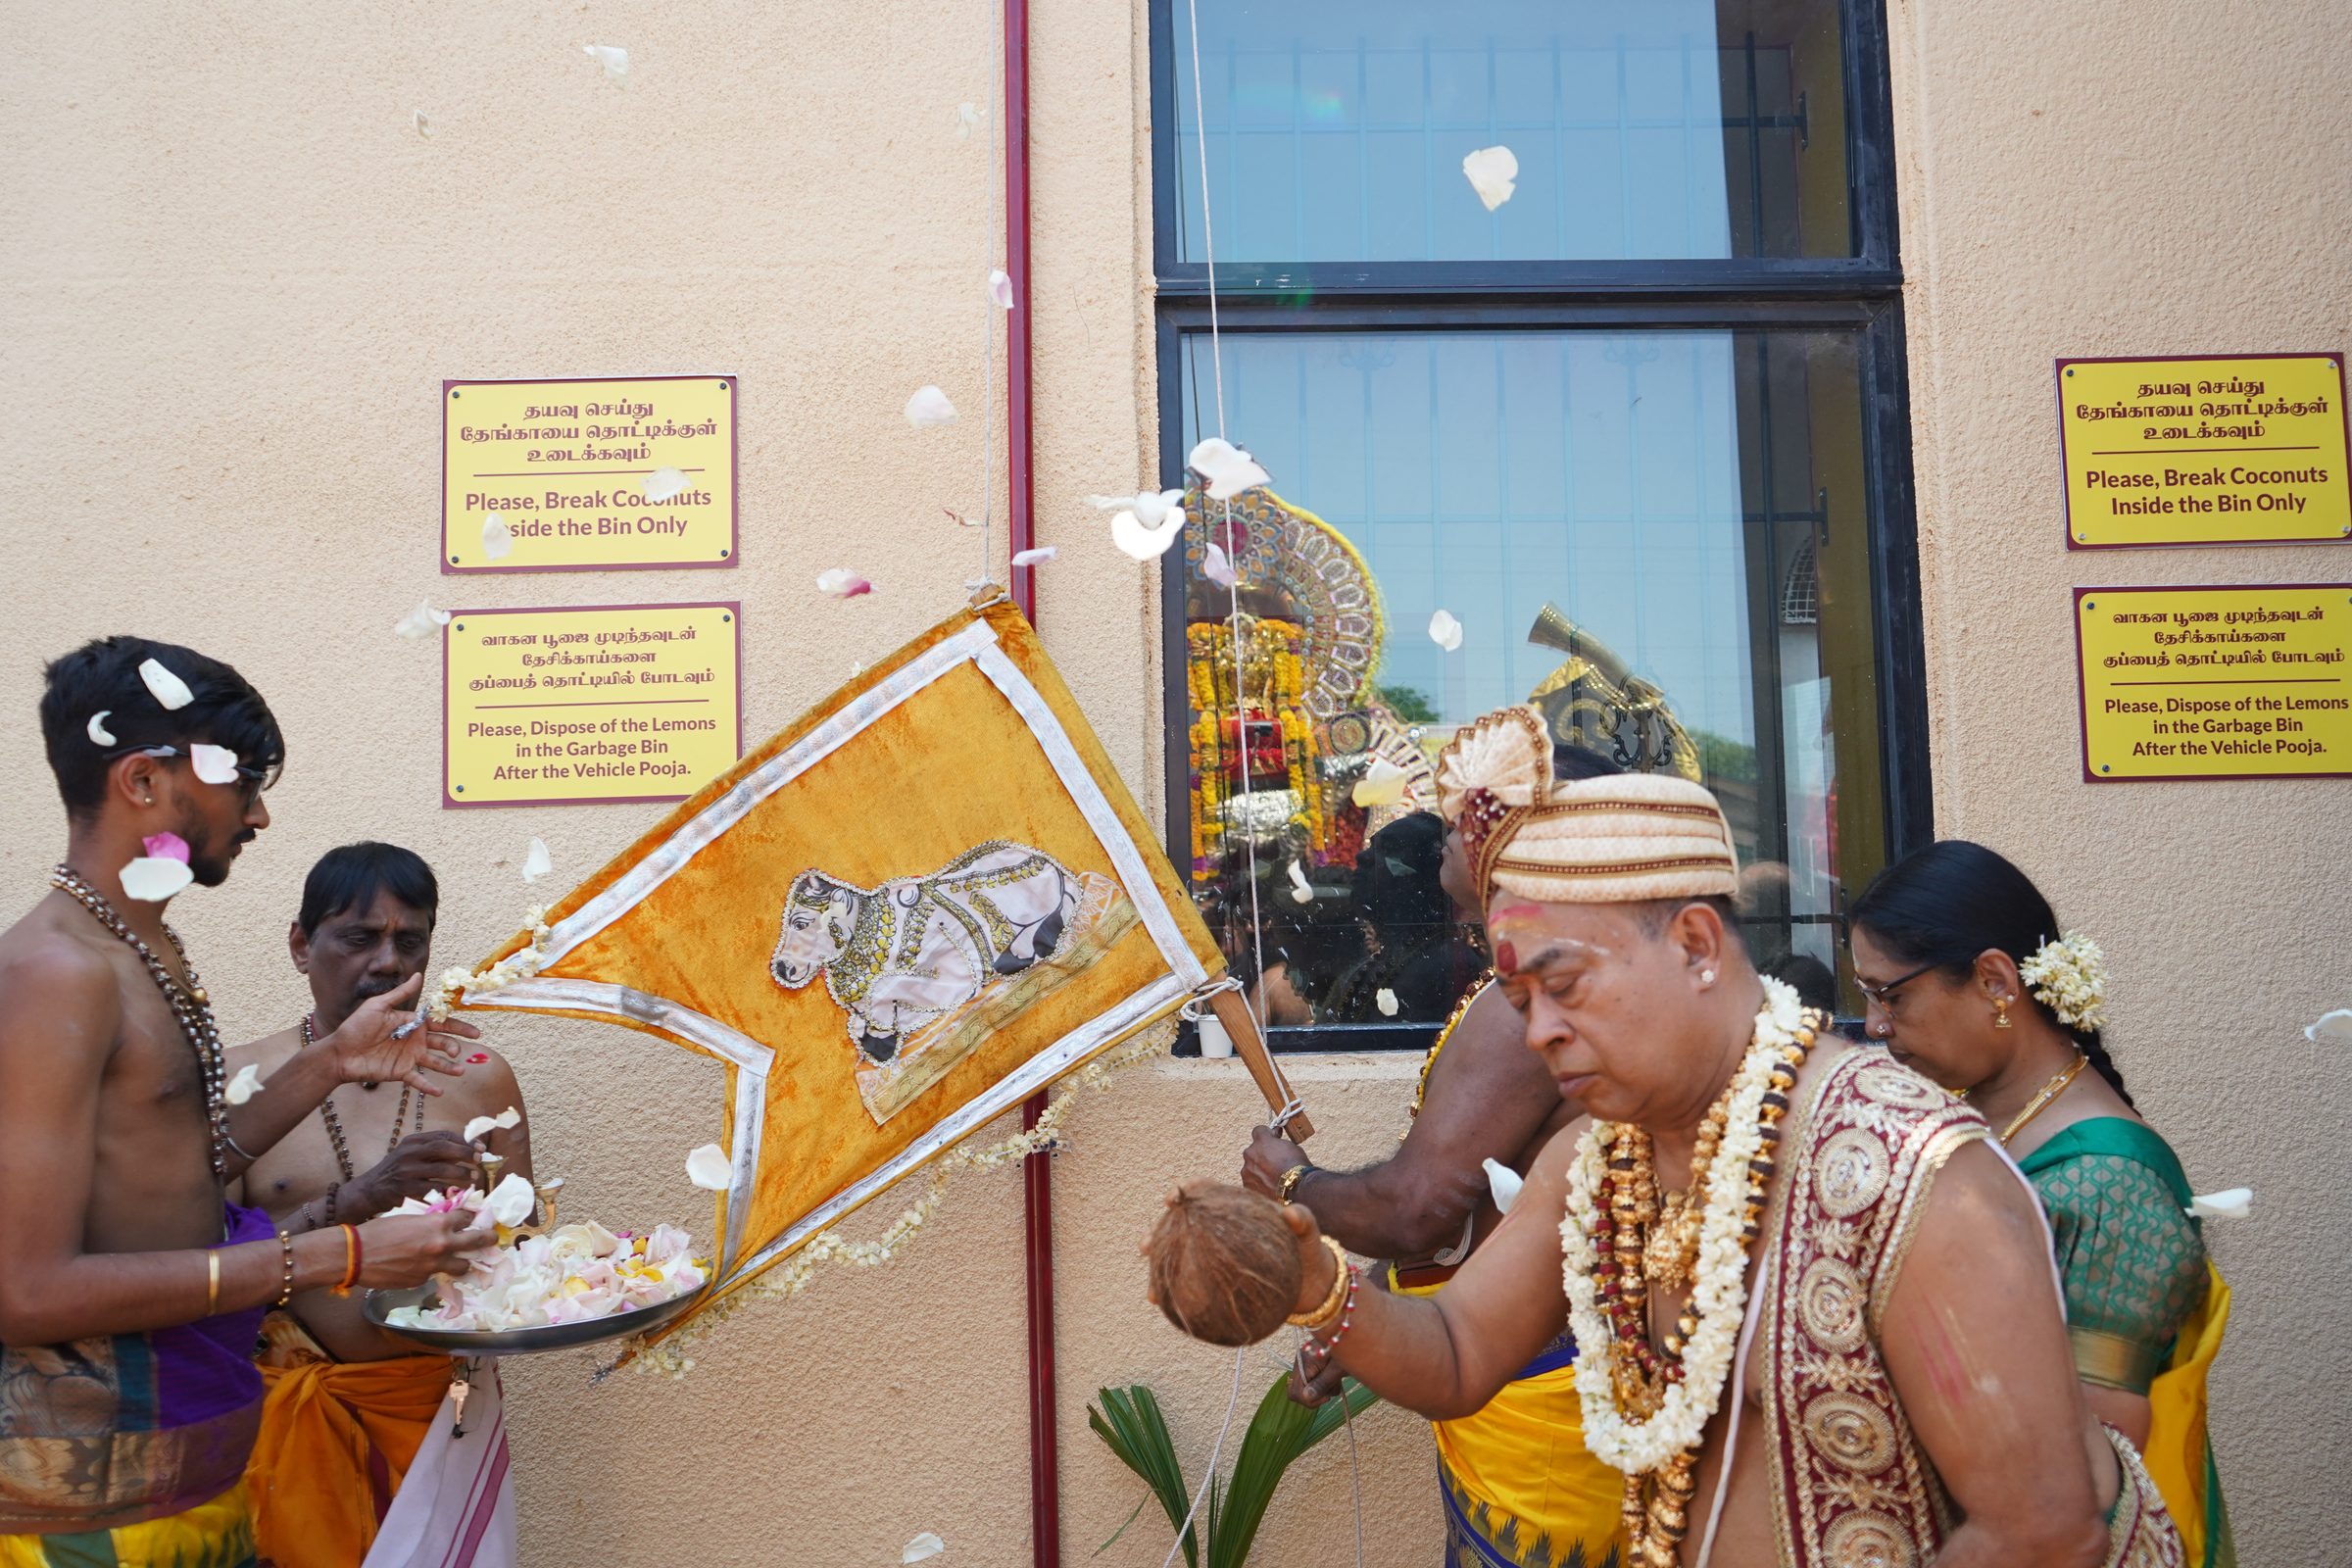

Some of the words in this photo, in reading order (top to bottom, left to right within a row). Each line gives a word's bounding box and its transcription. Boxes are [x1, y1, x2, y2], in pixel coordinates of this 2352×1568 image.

[2136, 382, 2191, 399] தயவு
[2197, 376, 2265, 398] செய்து
[523, 404, 578, 420] தயவு
[585, 398, 654, 419] செய்து
[2077, 402, 2194, 422] தேங்காயை
[2200, 397, 2328, 419] தொட்டிக்குள்
[461, 423, 579, 444] தேங்காயை
[586, 417, 717, 440] தொட்டிக்குள்
[2143, 420, 2265, 440] உடைக்கவும்
[527, 443, 651, 463] உடைக்கவும்
[2086, 470, 2160, 490] Please,
[2164, 468, 2226, 487] Break
[2230, 466, 2328, 485] Coconuts
[466, 493, 540, 512] Please,
[545, 491, 609, 510] Break
[2112, 496, 2174, 515] Inside
[2179, 495, 2213, 514] the
[2218, 494, 2252, 513] Bin
[2257, 492, 2307, 514] Only
[502, 518, 553, 537] side
[559, 517, 592, 536] the
[598, 516, 631, 535] Bin
[637, 515, 688, 537] Only
[2113, 612, 2168, 624] வாகன
[2173, 612, 2220, 627] பூஜை
[2224, 607, 2325, 625] முடிந்தவுடன்
[482, 634, 537, 647] வாகன
[543, 633, 589, 649] பூஜை
[594, 626, 697, 646] முடிந்தவுடன்
[2154, 629, 2286, 647] தேசிக்காய்களை
[522, 650, 658, 667] தேசிக்காய்களை
[2103, 652, 2171, 668] குப்பைத்
[2175, 650, 2267, 666] தொட்டியில்
[2272, 648, 2346, 664] போடவும்
[469, 673, 537, 692] குப்பைத்
[543, 670, 635, 689] தொட்டியில்
[640, 668, 715, 685] போடவும்
[2105, 699, 2163, 714] Please,
[2166, 698, 2230, 714] Dispose
[2234, 697, 2251, 711] of
[2255, 697, 2282, 710] the
[2286, 696, 2349, 710] Lemons
[468, 722, 527, 738] Please,
[530, 719, 597, 738] Dispose
[600, 718, 617, 733] of
[620, 718, 649, 732] the
[653, 717, 716, 731] Lemons
[2153, 720, 2169, 734] in
[2173, 719, 2199, 733] the
[2203, 718, 2273, 735] Garbage
[2276, 717, 2303, 732] Bin
[515, 743, 531, 758] in
[535, 742, 563, 757] the
[566, 740, 637, 759] Garbage
[641, 739, 668, 754] Bin
[2132, 741, 2176, 756] After
[2180, 741, 2208, 755] the
[2211, 740, 2272, 754] Vehicle
[2276, 739, 2328, 756] Pooja.
[493, 764, 538, 780] After
[542, 764, 569, 778] the
[573, 762, 635, 777] Vehicle
[639, 760, 692, 778] Pooja.
